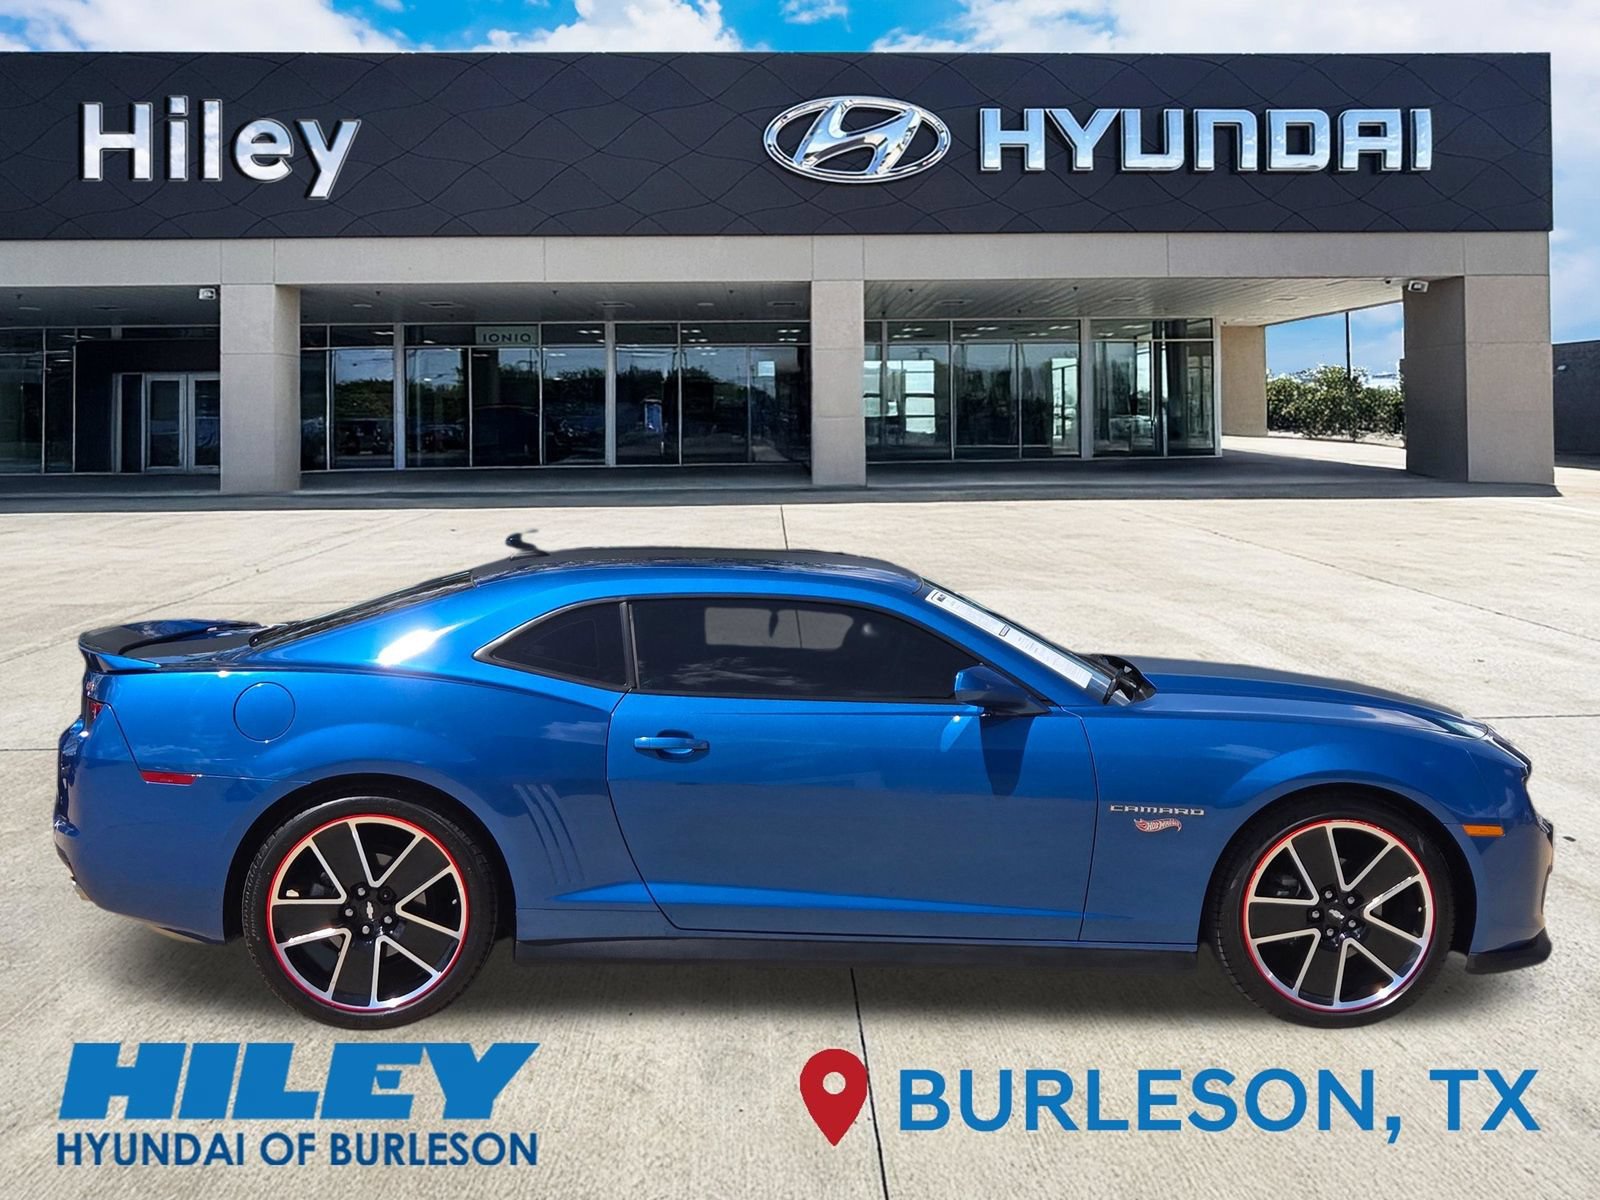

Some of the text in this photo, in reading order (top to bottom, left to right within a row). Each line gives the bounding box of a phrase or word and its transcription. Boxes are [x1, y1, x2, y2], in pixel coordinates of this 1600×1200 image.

[81, 95, 361, 199] Hiley
[979, 107, 1432, 172] HYUNDAI
[1110, 804, 1205, 816] CAMARO
